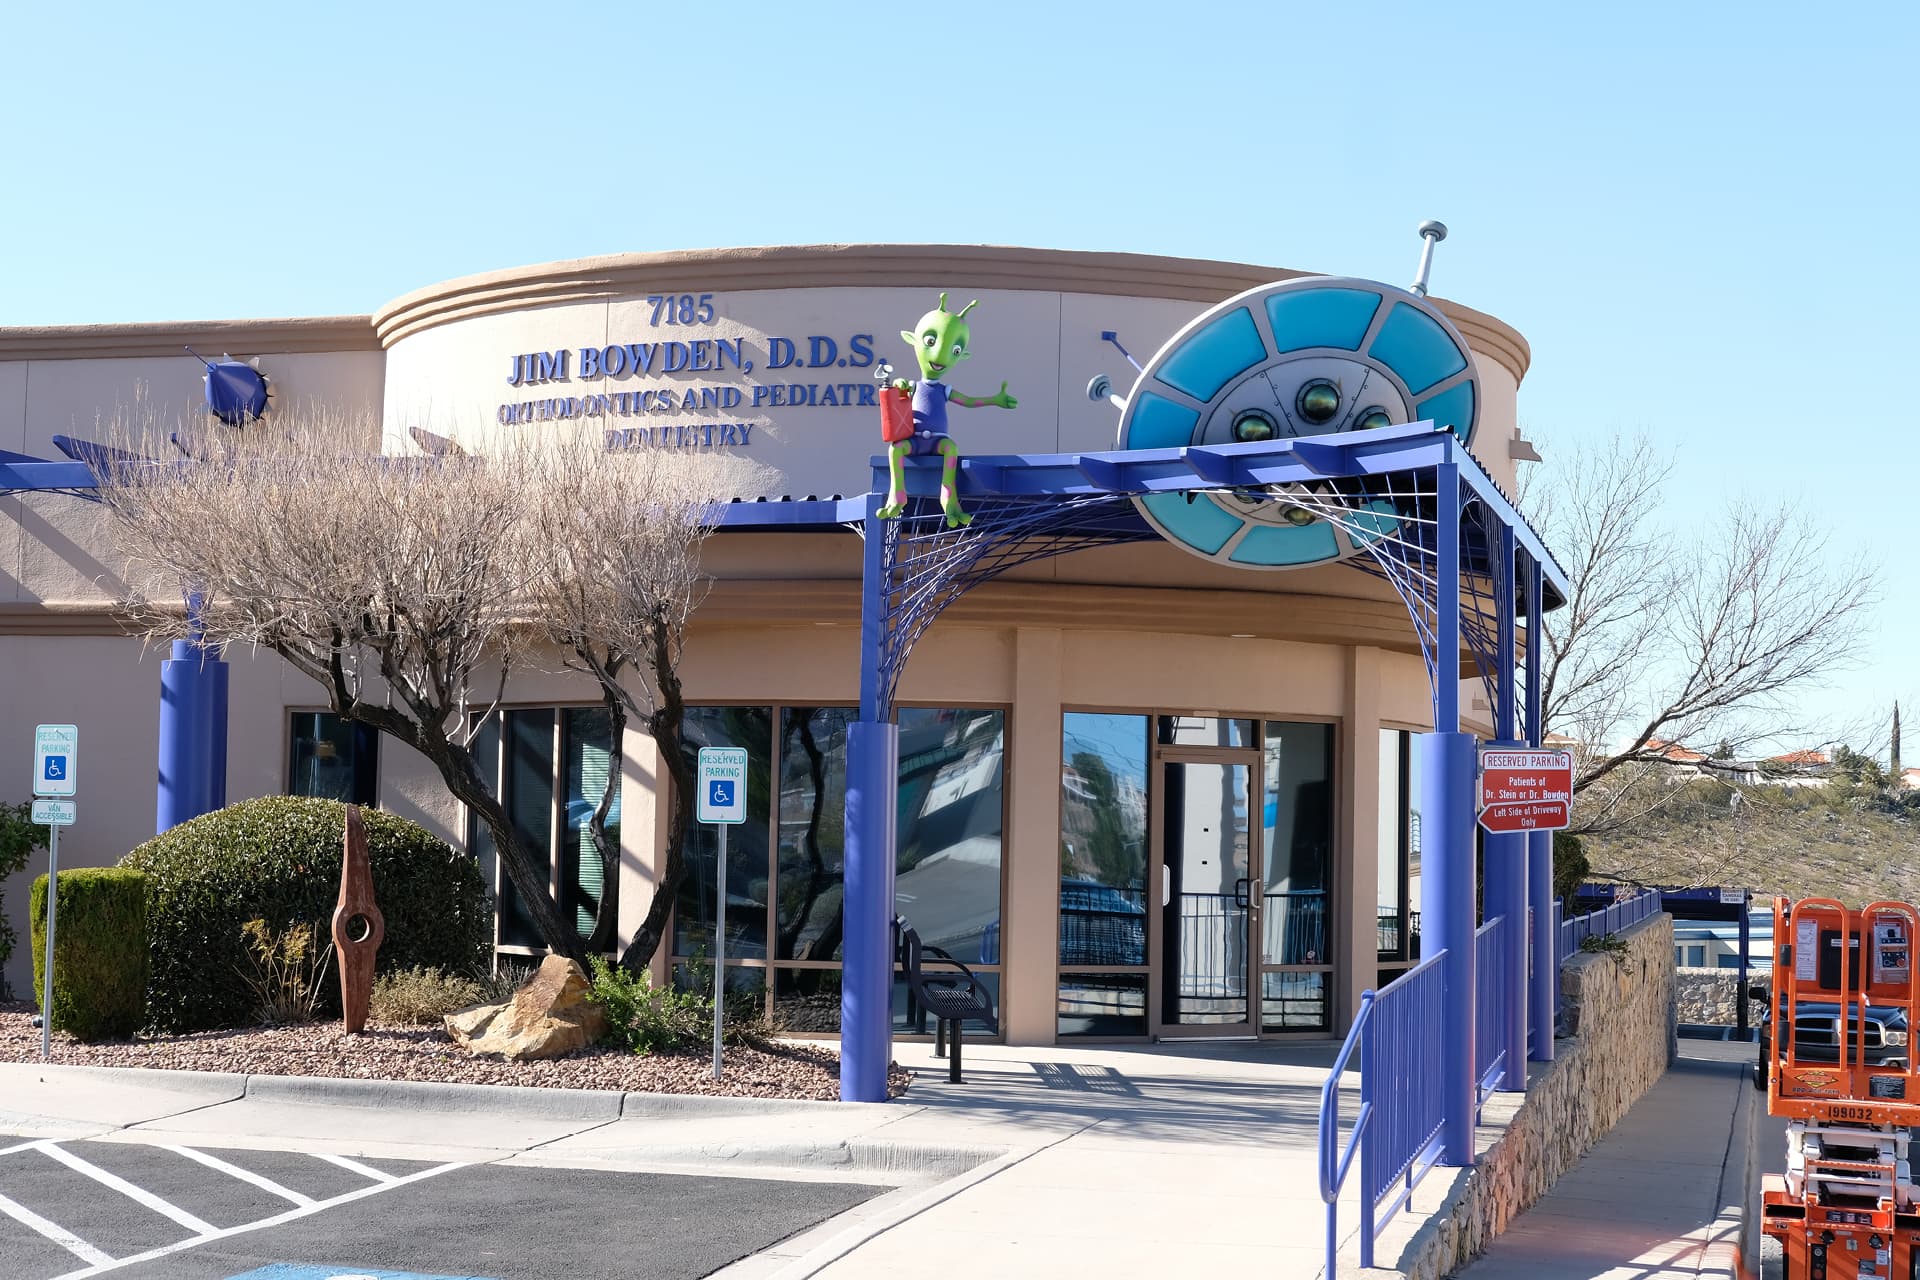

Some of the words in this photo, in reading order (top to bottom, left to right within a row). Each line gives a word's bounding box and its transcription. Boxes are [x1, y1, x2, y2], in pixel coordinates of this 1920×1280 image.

[646, 294, 714, 327] 7185
[506, 350, 565, 386] JIM
[578, 337, 753, 379] BOWDEN,
[766, 334, 887, 370] D.D.S.
[497, 388, 673, 425] ORTHODONTICS
[680, 386, 742, 410] AND
[751, 383, 882, 407] PEDIATR
[41, 744, 71, 753] PARKING
[702, 754, 744, 764] RESERVED
[1488, 756, 1527, 767] RESERVED
[1531, 756, 1566, 767] PARKING
[705, 767, 740, 777] PARKING
[1509, 777, 1536, 786] Patients
[1539, 777, 1546, 786] of
[1486, 790, 1495, 799] Dr.
[1499, 790, 1516, 799] Stein
[1530, 790, 1540, 799] Dr.
[1543, 790, 1569, 799] Bowden
[48, 804, 61, 812] VAN
[1494, 808, 1507, 817] Left
[1508, 808, 1522, 816] Side
[1524, 807, 1531, 815] of
[1533, 805, 1562, 815] Driveway
[35, 812, 73, 821] ACCESSIBLE
[1521, 817, 1536, 828] Only
[1828, 1106, 1873, 1120] 199032
